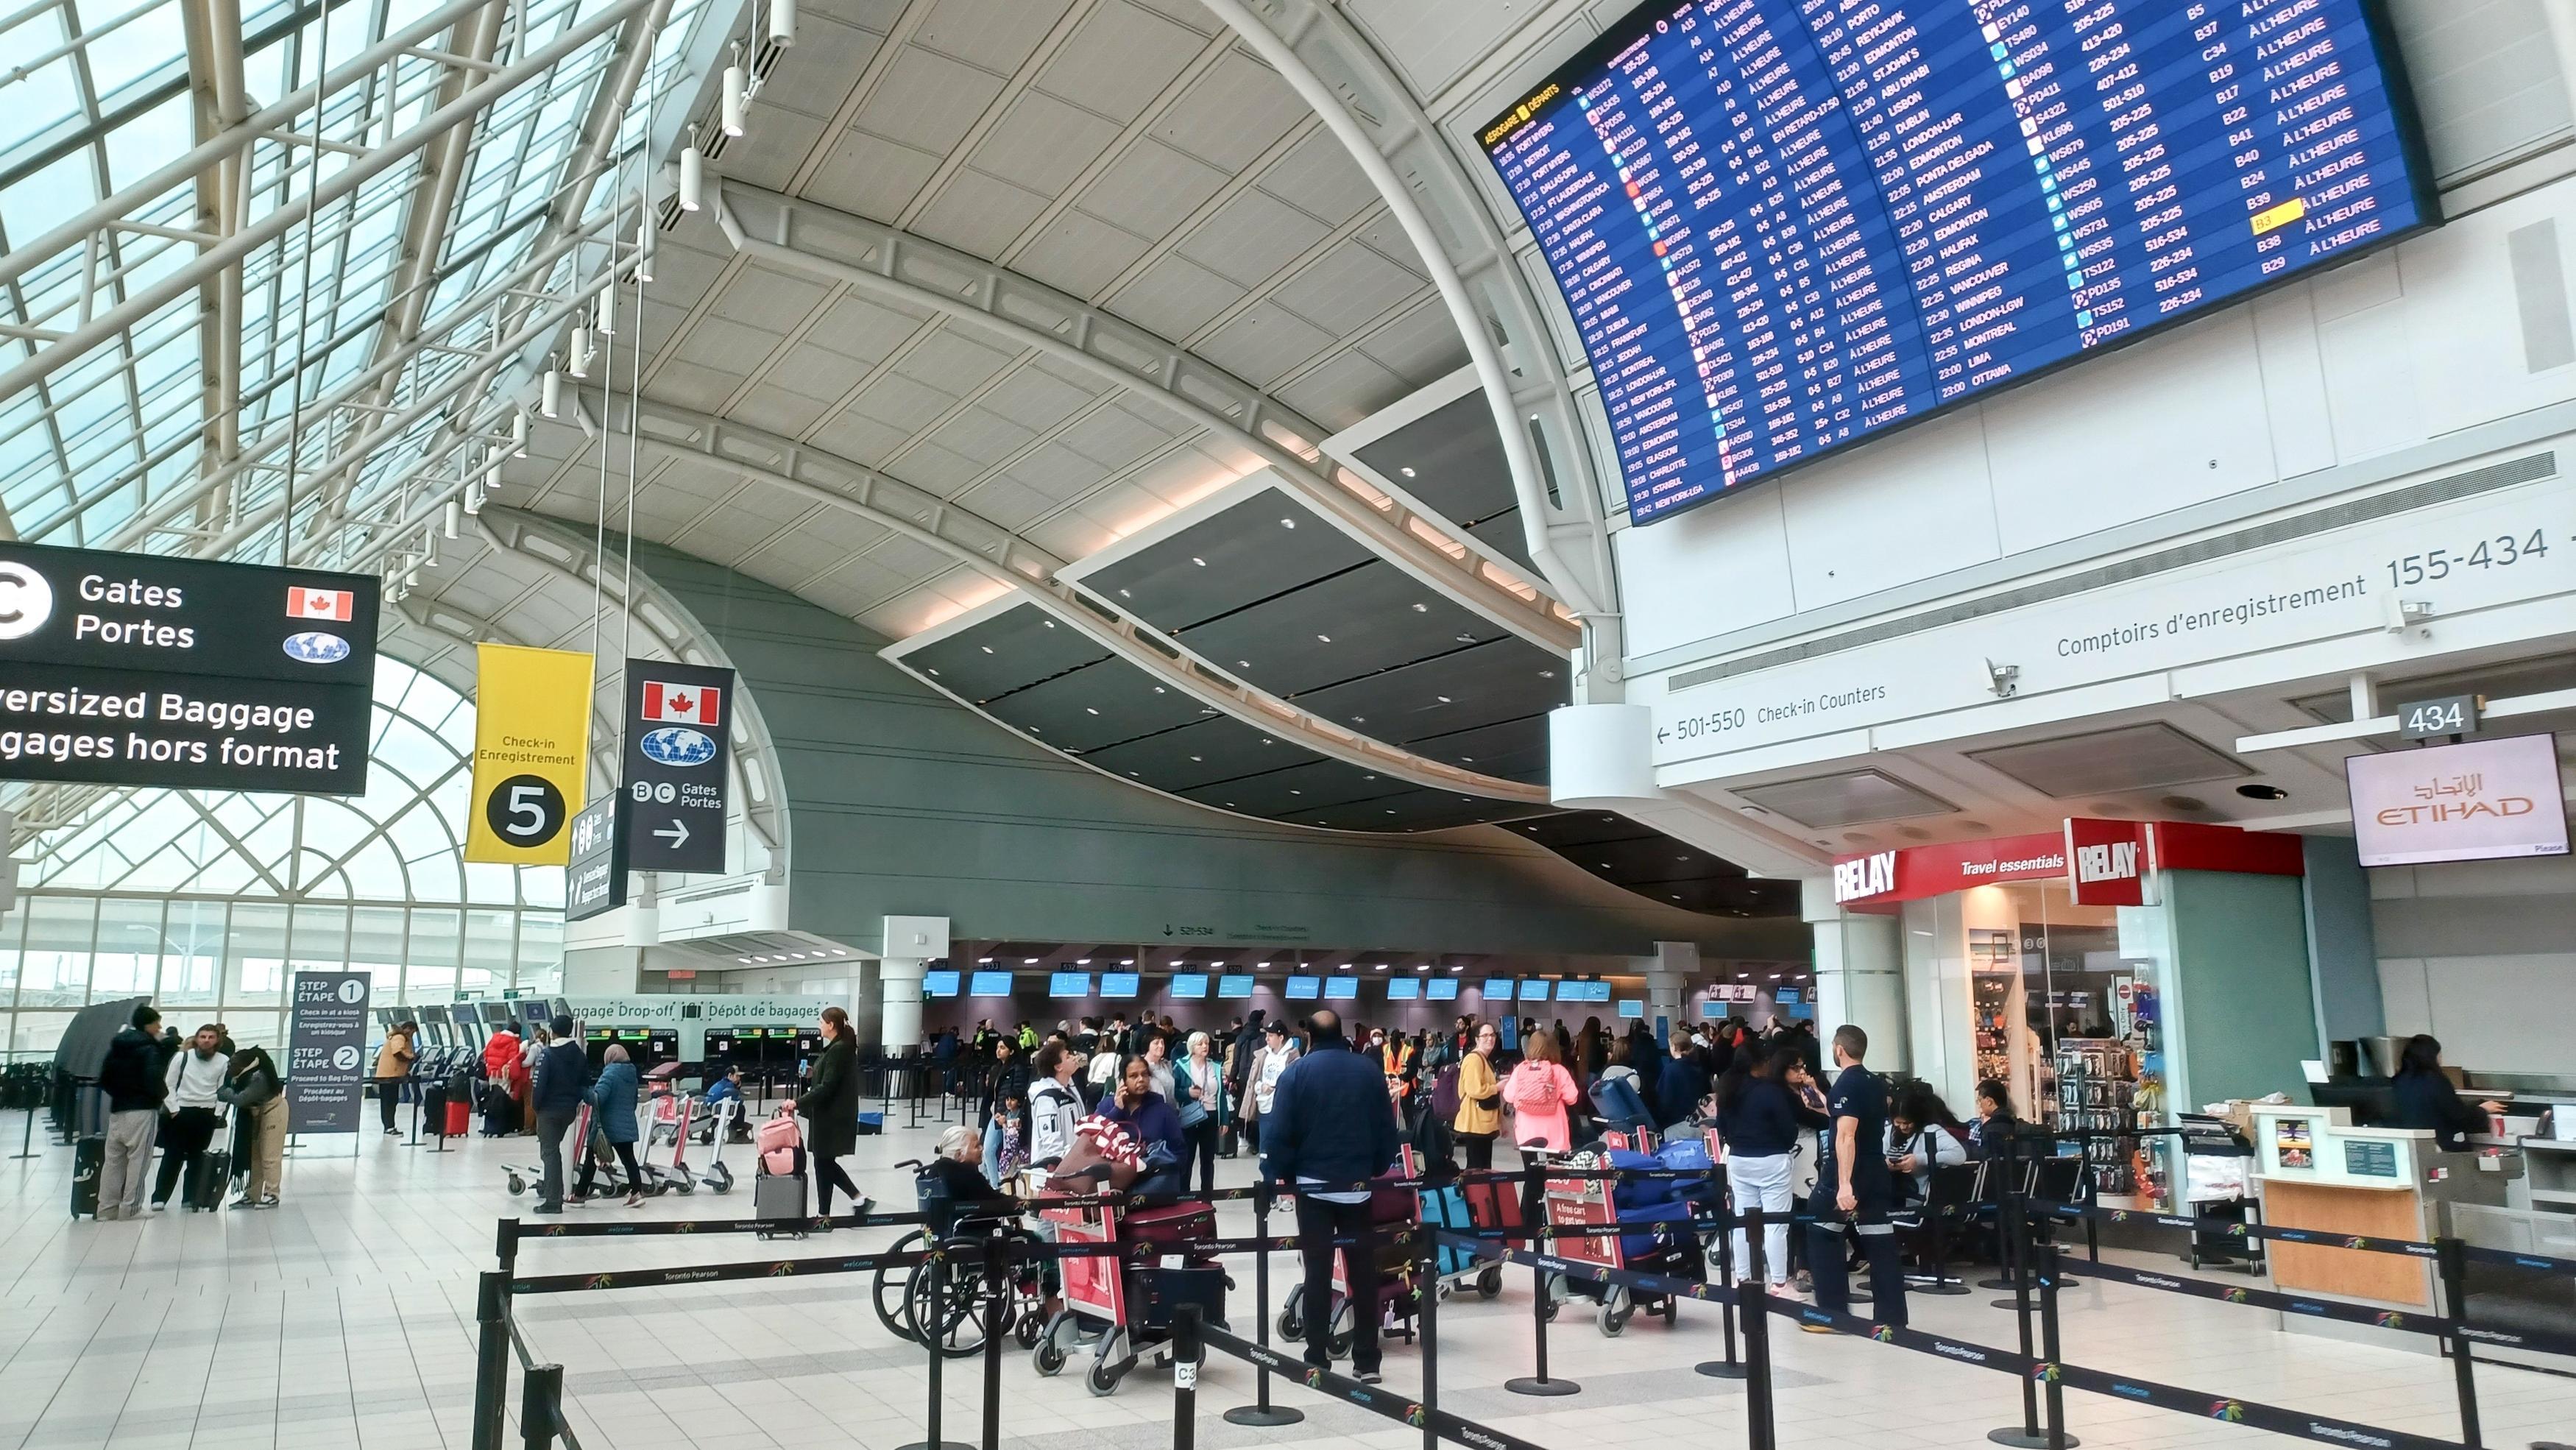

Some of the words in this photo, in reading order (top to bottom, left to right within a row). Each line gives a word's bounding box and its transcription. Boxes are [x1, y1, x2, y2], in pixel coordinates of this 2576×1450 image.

[1819, 27, 1843, 48] 20:10
[1847, 4, 1879, 29] PORTO
[1828, 44, 1852, 65] 20:45
[1855, 10, 1905, 46] REYKJAVIK
[1866, 131, 1890, 150] 21:50
[1894, 108, 1929, 134] DUBLIN
[2012, 41, 2048, 66] WS034
[2073, 2, 2115, 33] 205-225
[1485, 114, 1519, 144] AÉROGARE
[1528, 84, 1560, 111] DÉPARTS
[1893, 201, 1917, 220] 22:15
[1923, 168, 1981, 205] AMSTERDAM
[2042, 121, 2073, 144] KL696
[2102, 83, 2144, 111] 501-510
[2202, 42, 2226, 61] C34
[2249, 24, 2260, 38] À
[2260, 0, 2318, 32] L'HEURE
[1911, 255, 1934, 272] 22:20
[1939, 233, 1978, 259] HALIFAX
[2060, 177, 2096, 200] WS250
[2122, 144, 2165, 171] 205-225
[2222, 106, 2247, 125] B22
[2270, 88, 2281, 103] À
[2281, 62, 2339, 97] L'HEURE
[1575, 239, 1606, 263] WINNIPEG
[1687, 171, 1714, 194] 205-225
[1747, 144, 1763, 158] B41
[1772, 129, 1786, 143] EN
[1921, 290, 1945, 308] 22:25
[1950, 262, 2008, 294] VANCOUVER
[2071, 217, 2108, 239] WS731
[2134, 185, 2176, 211] 205-225
[2234, 149, 2259, 167] B40
[2282, 132, 2295, 146] À
[2294, 106, 2352, 141] L'HEURE
[2256, 216, 2272, 230] B3
[1930, 326, 1953, 344] 22:35
[1959, 297, 2023, 331] LONDON-LGW
[2082, 258, 2115, 278] TS122
[2145, 226, 2187, 252] 516-534
[2246, 191, 2271, 210] B39
[2294, 175, 2306, 190] À
[2305, 151, 2364, 184] L'HEURE
[1938, 363, 1961, 380] 23:00
[1967, 351, 1992, 368] LIMA
[2092, 297, 2124, 317] TS152
[2154, 267, 2197, 291] 516-534
[2256, 235, 2281, 252] B38
[2304, 219, 2317, 233] À
[2316, 197, 2374, 228] L'HEURE
[1942, 381, 1965, 397] 23:00
[1971, 364, 2011, 385] OTTAWA
[2096, 317, 2130, 337] PD191
[2159, 288, 2201, 312] 226-234
[2261, 256, 2285, 274] B29
[2309, 241, 2321, 255] À
[2321, 219, 2379, 250] L'HEURE
[1731, 447, 1754, 462] BG306
[1834, 408, 1850, 421] C32
[2386, 528, 2549, 588] 155-434
[79, 574, 183, 608] Gates
[76, 614, 194, 648] Portes
[2058, 617, 2159, 657] Comptoirs
[2166, 575, 2366, 635] d'enregistrement
[160, 693, 314, 734] Baggage
[1677, 707, 1745, 741] 501-550
[1758, 698, 1815, 724] Check-in
[1819, 683, 1886, 712] Counters
[2408, 702, 2464, 732] 434
[127, 732, 208, 764] hors
[221, 737, 340, 771] format
[479, 751, 576, 765] Enregistrement
[502, 735, 555, 750] Check-in
[681, 796, 722, 809] Portes
[682, 783, 718, 796] Gates
[506, 785, 546, 836] 5
[2377, 796, 2534, 827] ETIHAD
[1834, 850, 1897, 904] RELAY
[1961, 859, 1997, 875] Travel
[2000, 853, 2064, 874] essentials
[2077, 841, 2137, 883] RELAY
[1179, 926, 1214, 936] 521-534
[298, 991, 335, 1002] ÉTAPE
[299, 981, 328, 991] STEP
[347, 983, 353, 1000] 1
[556, 1005, 614, 1019] ggage
[619, 1004, 675, 1020] Drop-off
[710, 1004, 746, 1019] Dépôt
[750, 1005, 765, 1016] de
[768, 1005, 819, 1019] bagages
[292, 1058, 330, 1069] ÉTAPE
[294, 1048, 323, 1058] STEP
[339, 1049, 353, 1065] 2
[291, 1075, 319, 1083] Proceed
[1557, 1203, 1562, 1212] A
[607, 1225, 634, 1234] welcome
[734, 1222, 754, 1230] Toronto
[754, 1221, 775, 1229] Pearson
[664, 1272, 691, 1281] Toronto
[691, 1270, 719, 1281] Pearson
[843, 1260, 873, 1269] welcome
[1178, 1368, 1197, 1382] C3
